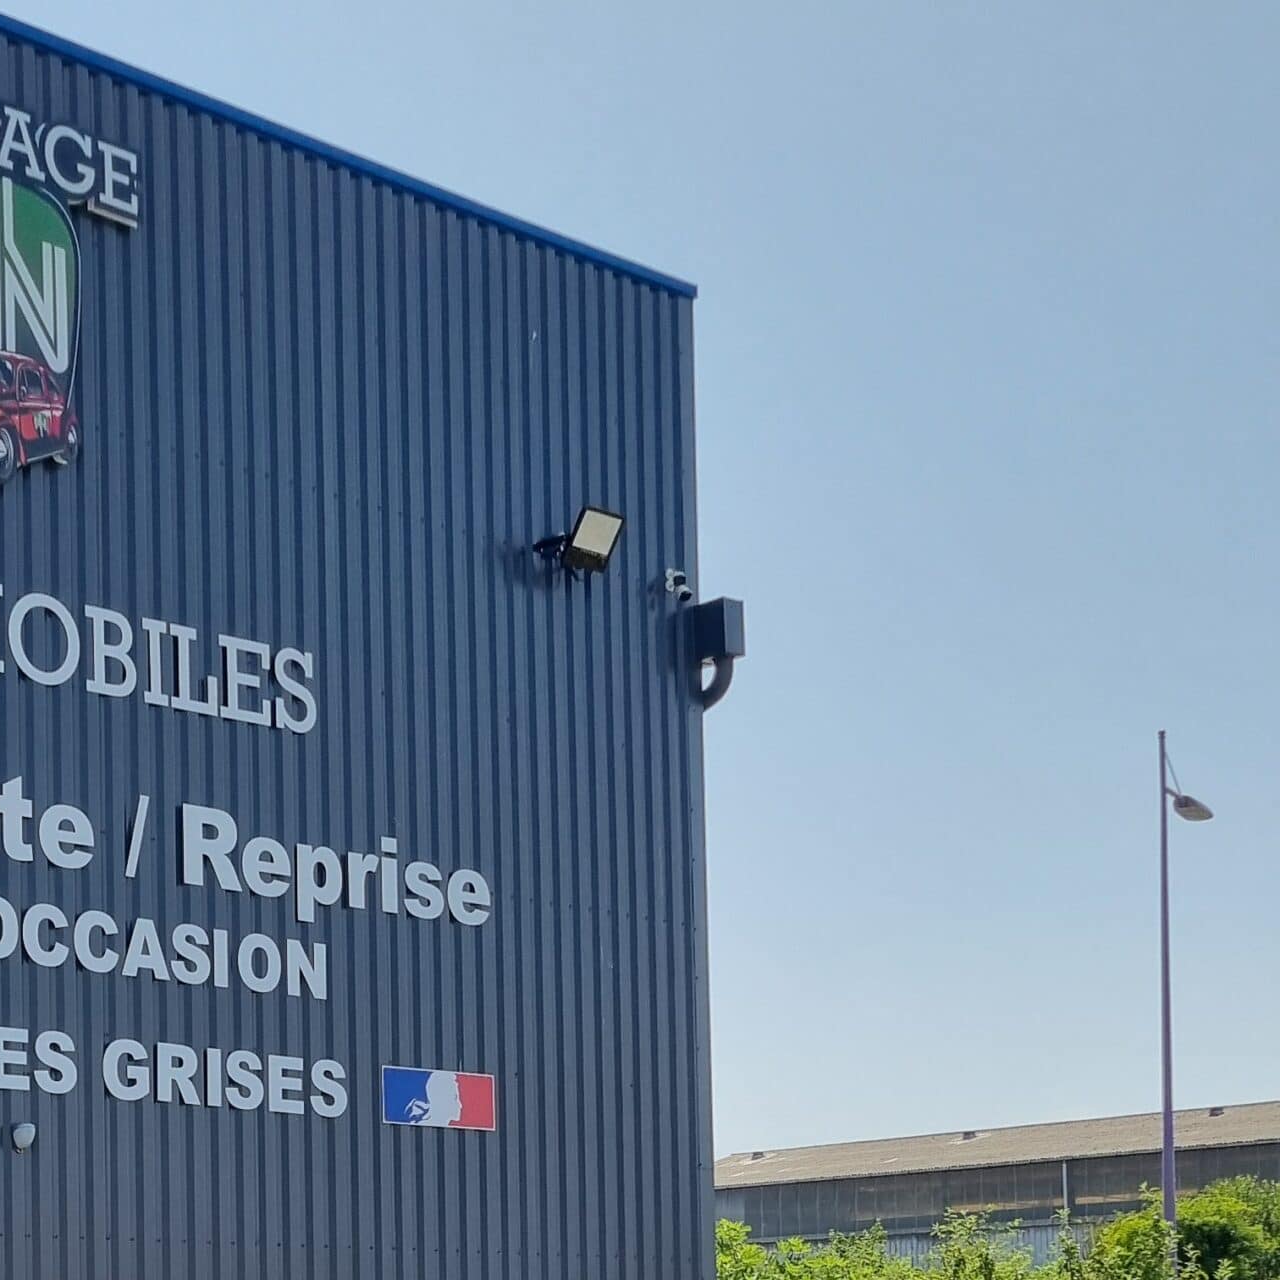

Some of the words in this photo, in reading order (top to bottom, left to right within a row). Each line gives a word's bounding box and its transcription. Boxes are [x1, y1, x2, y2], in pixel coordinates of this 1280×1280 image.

[124, 794, 150, 878] /
[181, 802, 492, 926] Reprise
[102, 1038, 348, 1119] GRISES
